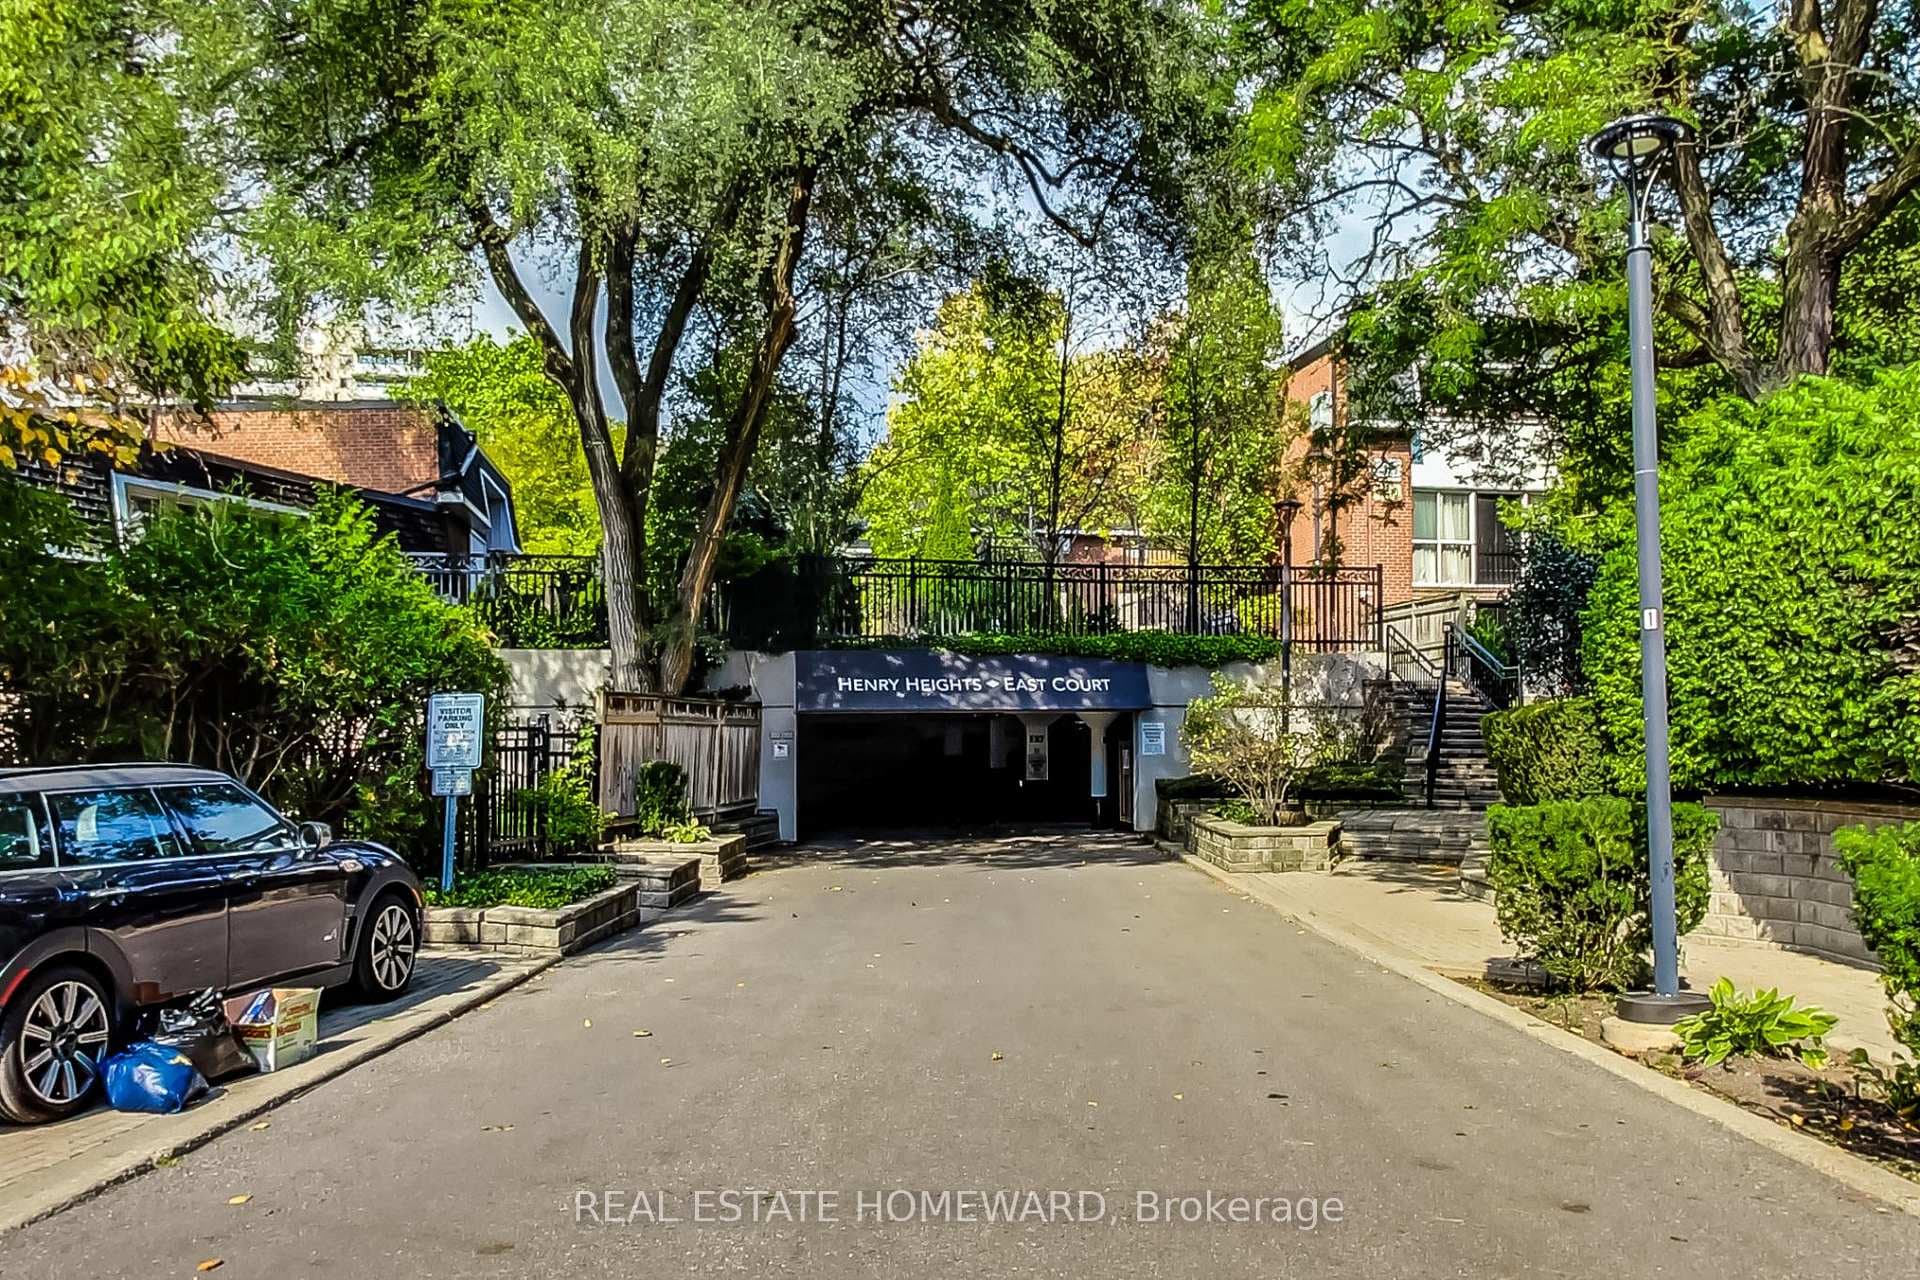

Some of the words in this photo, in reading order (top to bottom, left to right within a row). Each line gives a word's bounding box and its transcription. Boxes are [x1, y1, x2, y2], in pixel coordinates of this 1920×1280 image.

[837, 677, 900, 692] HENRY
[905, 677, 982, 692] HEIGHTS
[1003, 677, 1047, 692] EAST
[1051, 677, 1111, 692] COURT
[440, 707, 472, 715] VISITOR
[444, 722, 466, 730] ONLY
